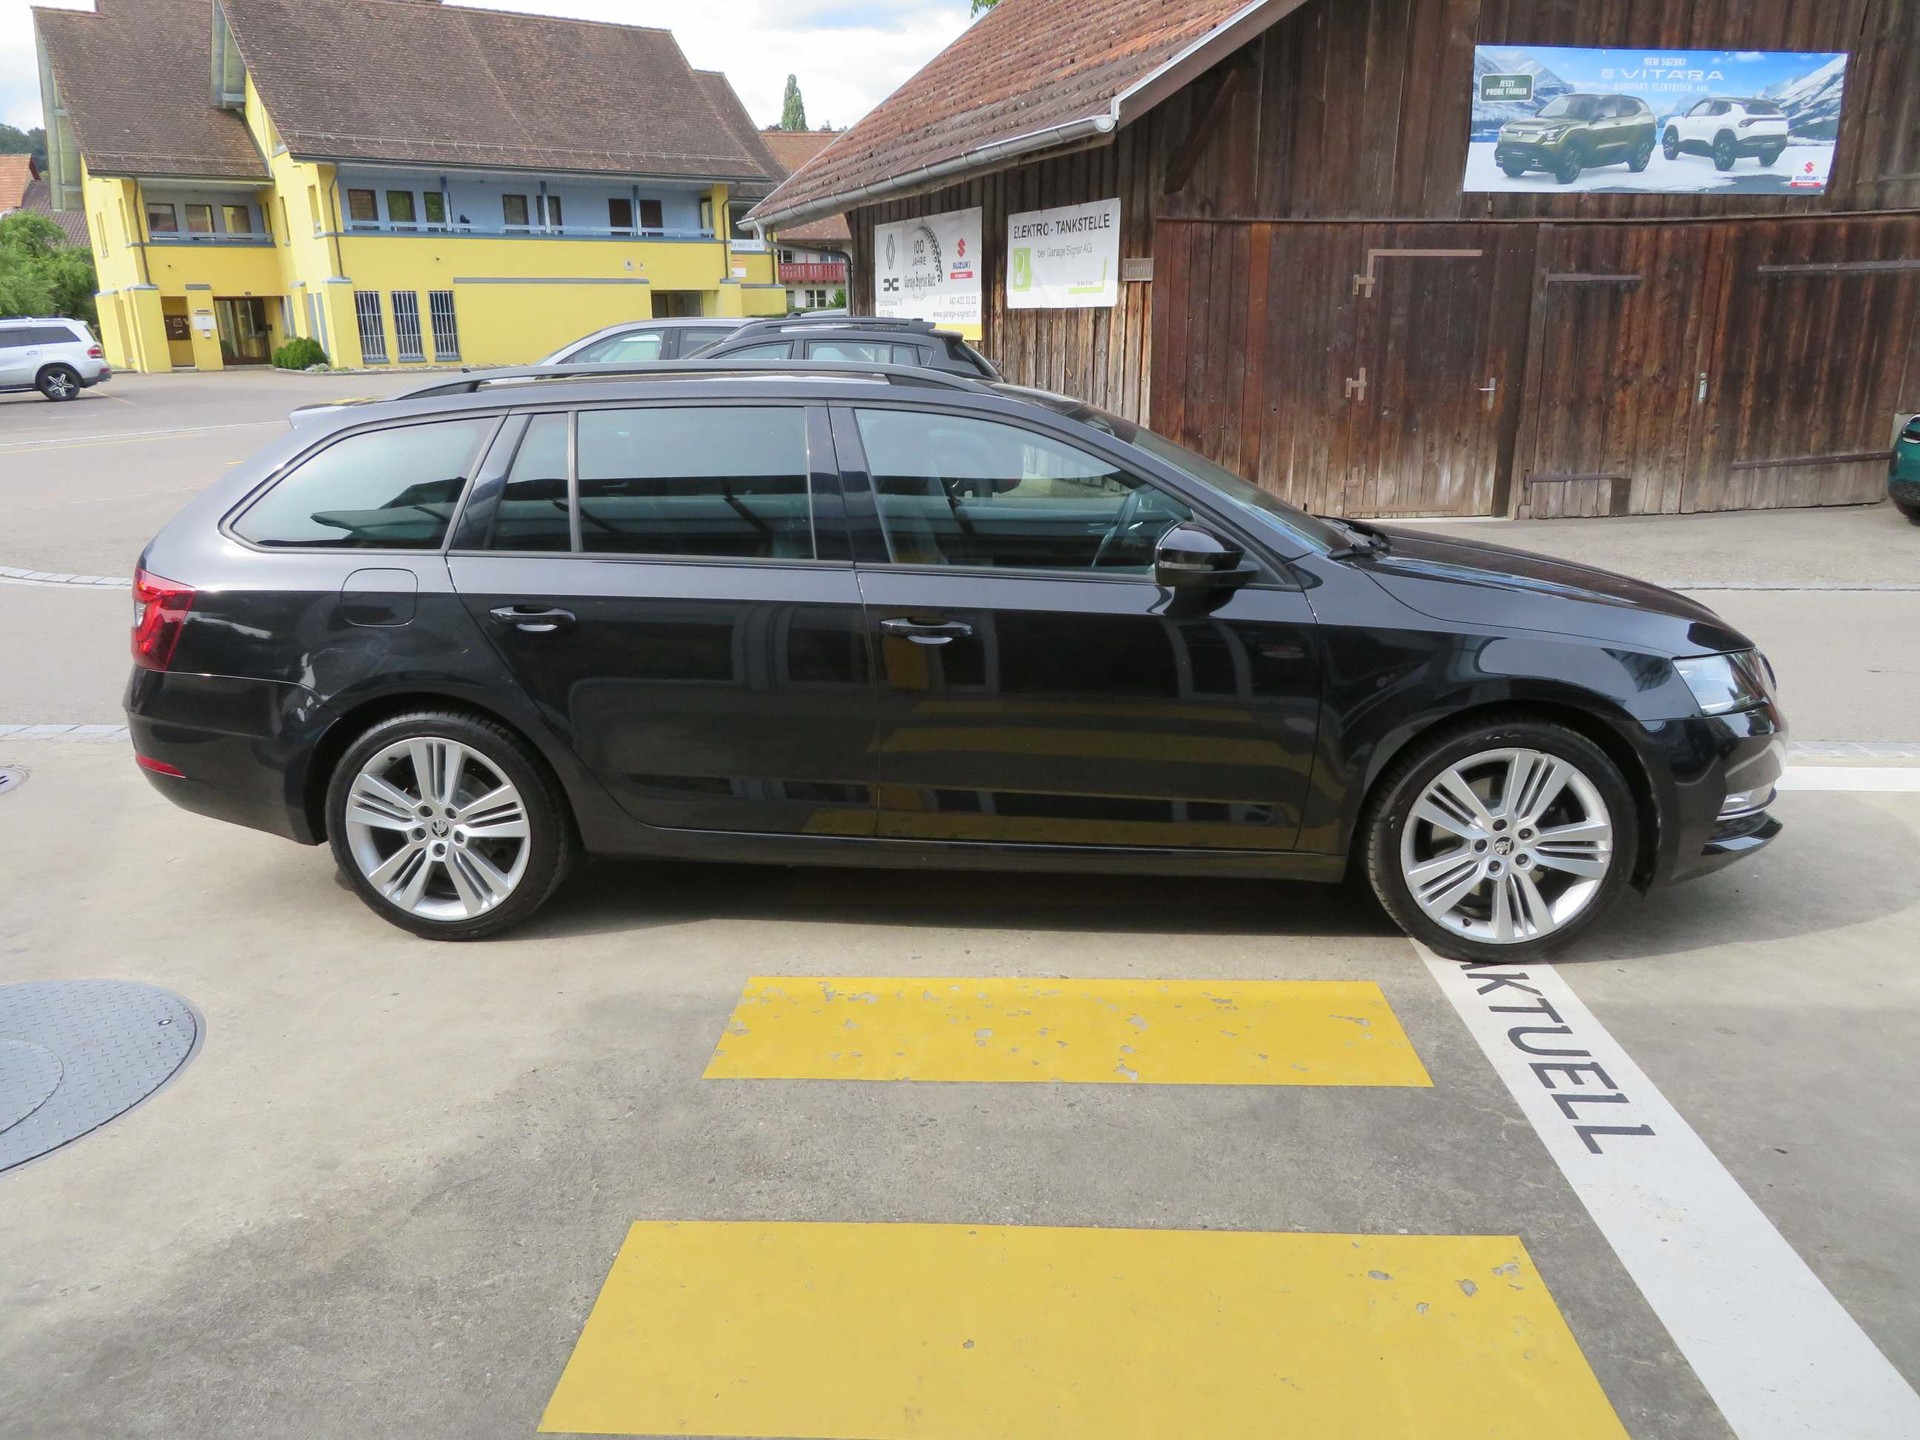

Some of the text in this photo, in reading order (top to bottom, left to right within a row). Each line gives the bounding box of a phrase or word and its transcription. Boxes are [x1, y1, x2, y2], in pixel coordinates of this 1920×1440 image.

[1661, 58, 1687, 67] SUZUKI
[1621, 69, 1724, 80] VITARA
[1499, 80, 1515, 88] JETZT
[1485, 87, 1528, 96] PROBE FAHREN
[1013, 222, 1049, 239] ELEKTRO
[1055, 213, 1110, 235] TANKSTELLE
[913, 239, 925, 255] 100
[1046, 246, 1066, 259] Garage
[1083, 242, 1093, 254] AG
[912, 256, 927, 267] JAHRE
[952, 260, 971, 271] SUZUKI
[1460, 962, 1656, 1154] KTUELL
